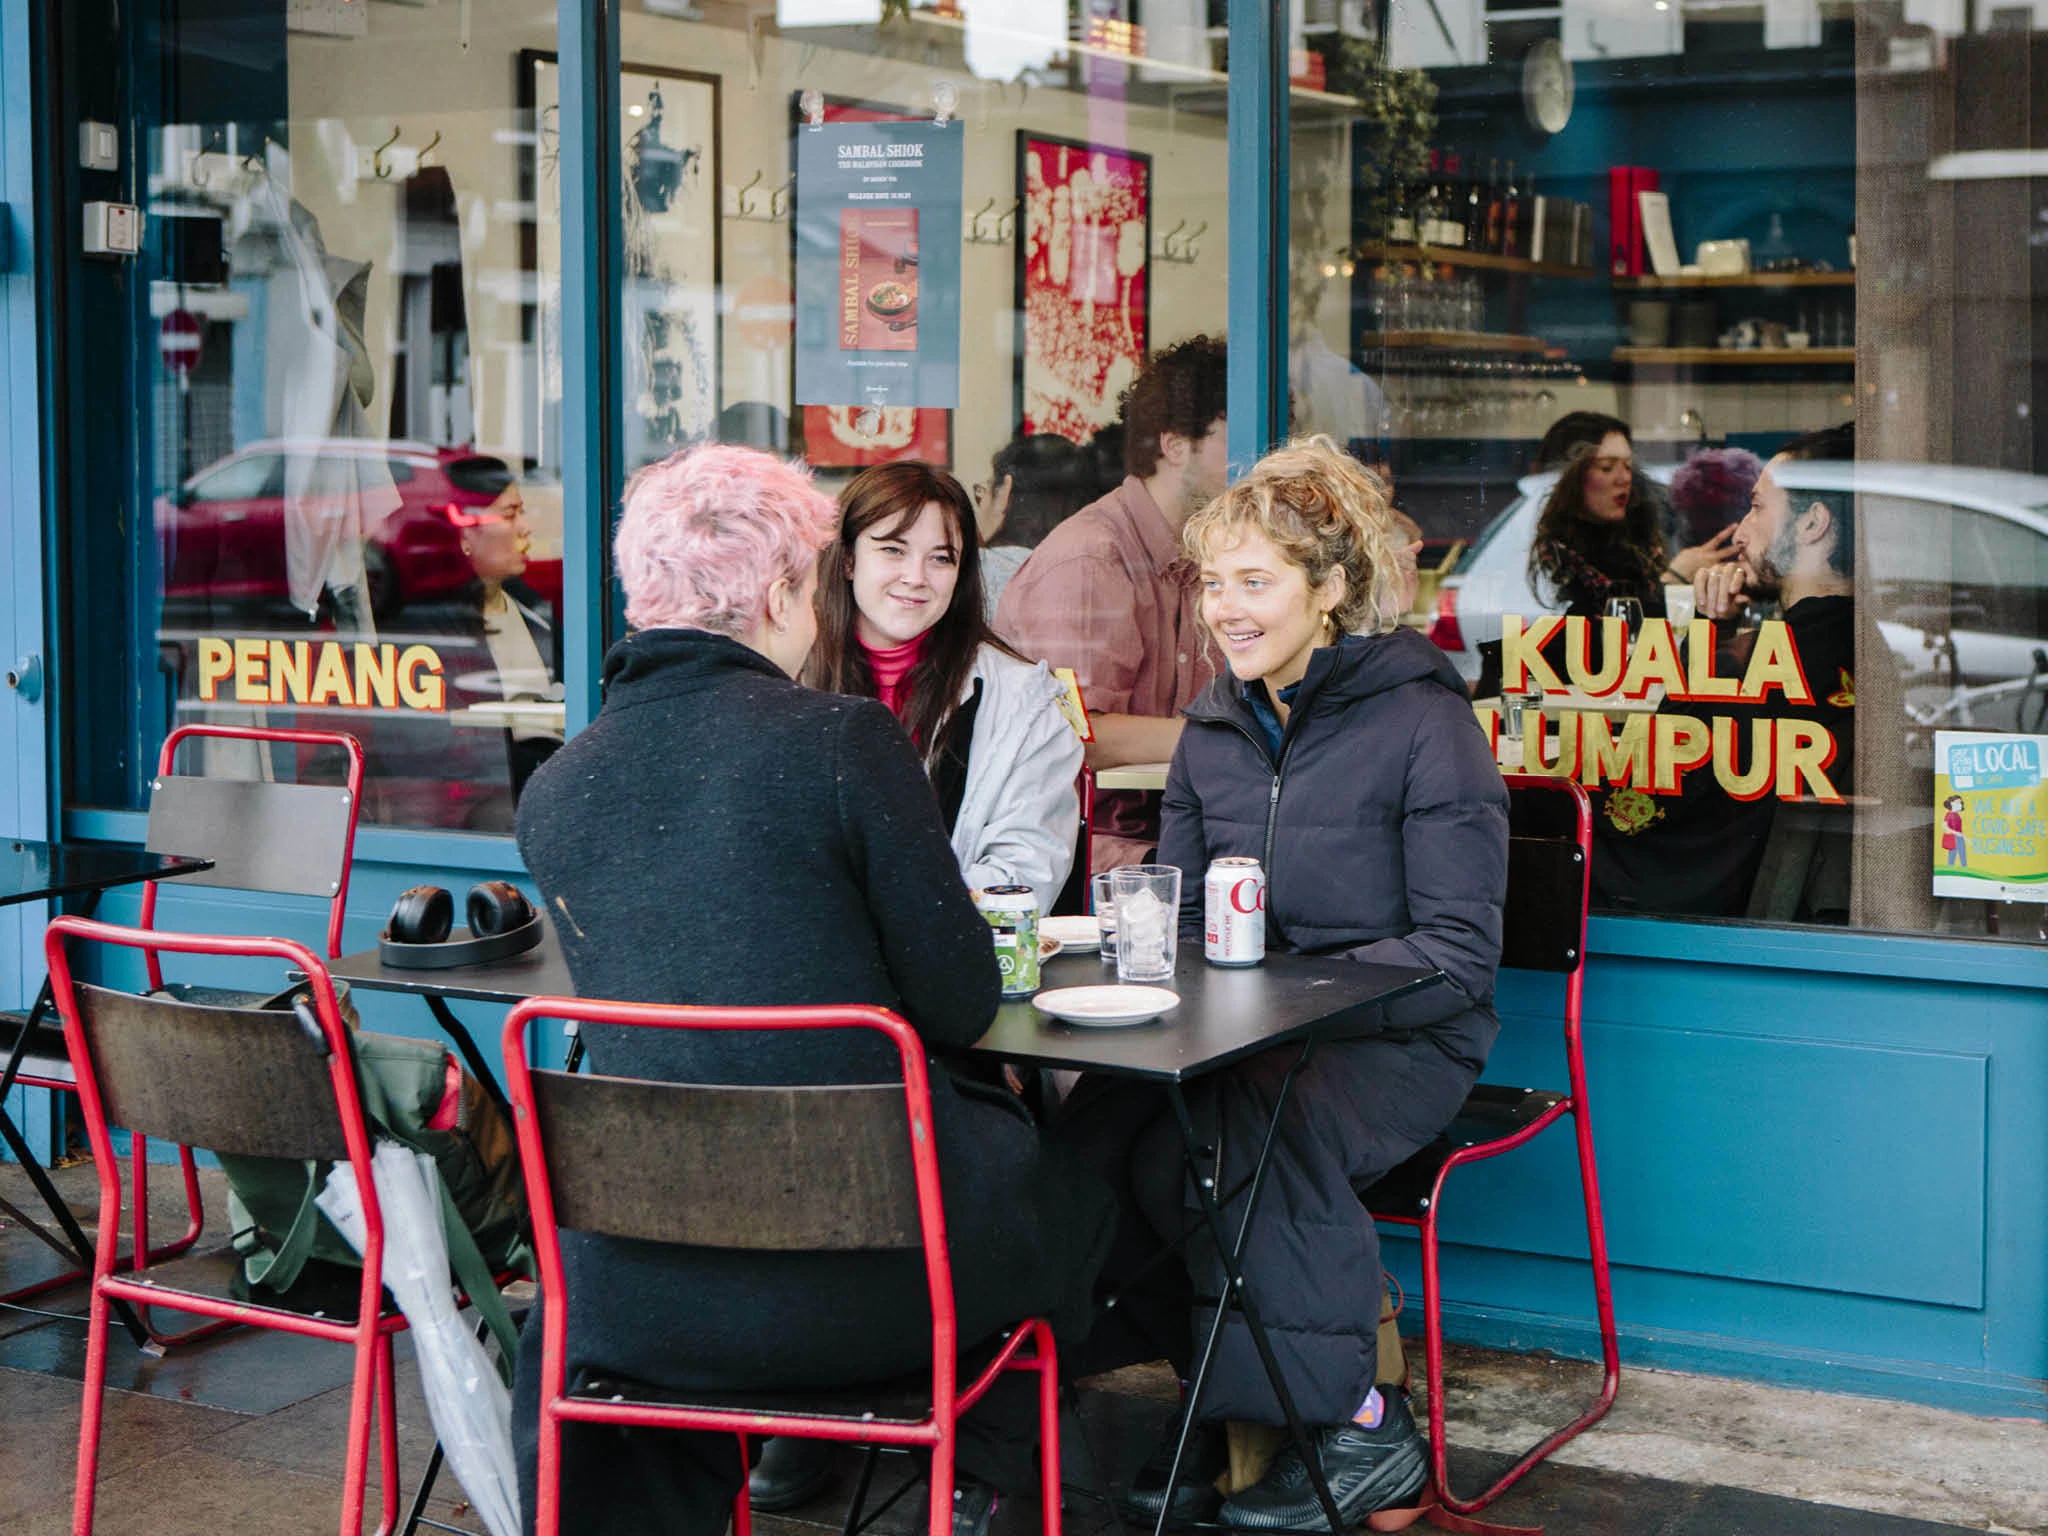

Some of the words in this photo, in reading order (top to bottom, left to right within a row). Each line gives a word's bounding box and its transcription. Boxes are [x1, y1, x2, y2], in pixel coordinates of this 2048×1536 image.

[838, 144, 885, 158] SAMBAL
[887, 144, 924, 157] SHIOK
[844, 274, 859, 345] SAMBAL
[1502, 614, 1816, 705] KUALA
[198, 637, 446, 713] PENANG
[1972, 743, 2037, 773] LOCAL
[1972, 797, 1995, 815] WE
[2000, 799, 2023, 816] ARE
[2027, 800, 2037, 816] A
[1972, 817, 2010, 836] COVID
[2016, 819, 2047, 838] SAFE
[1972, 837, 2035, 857] BUSINESS
